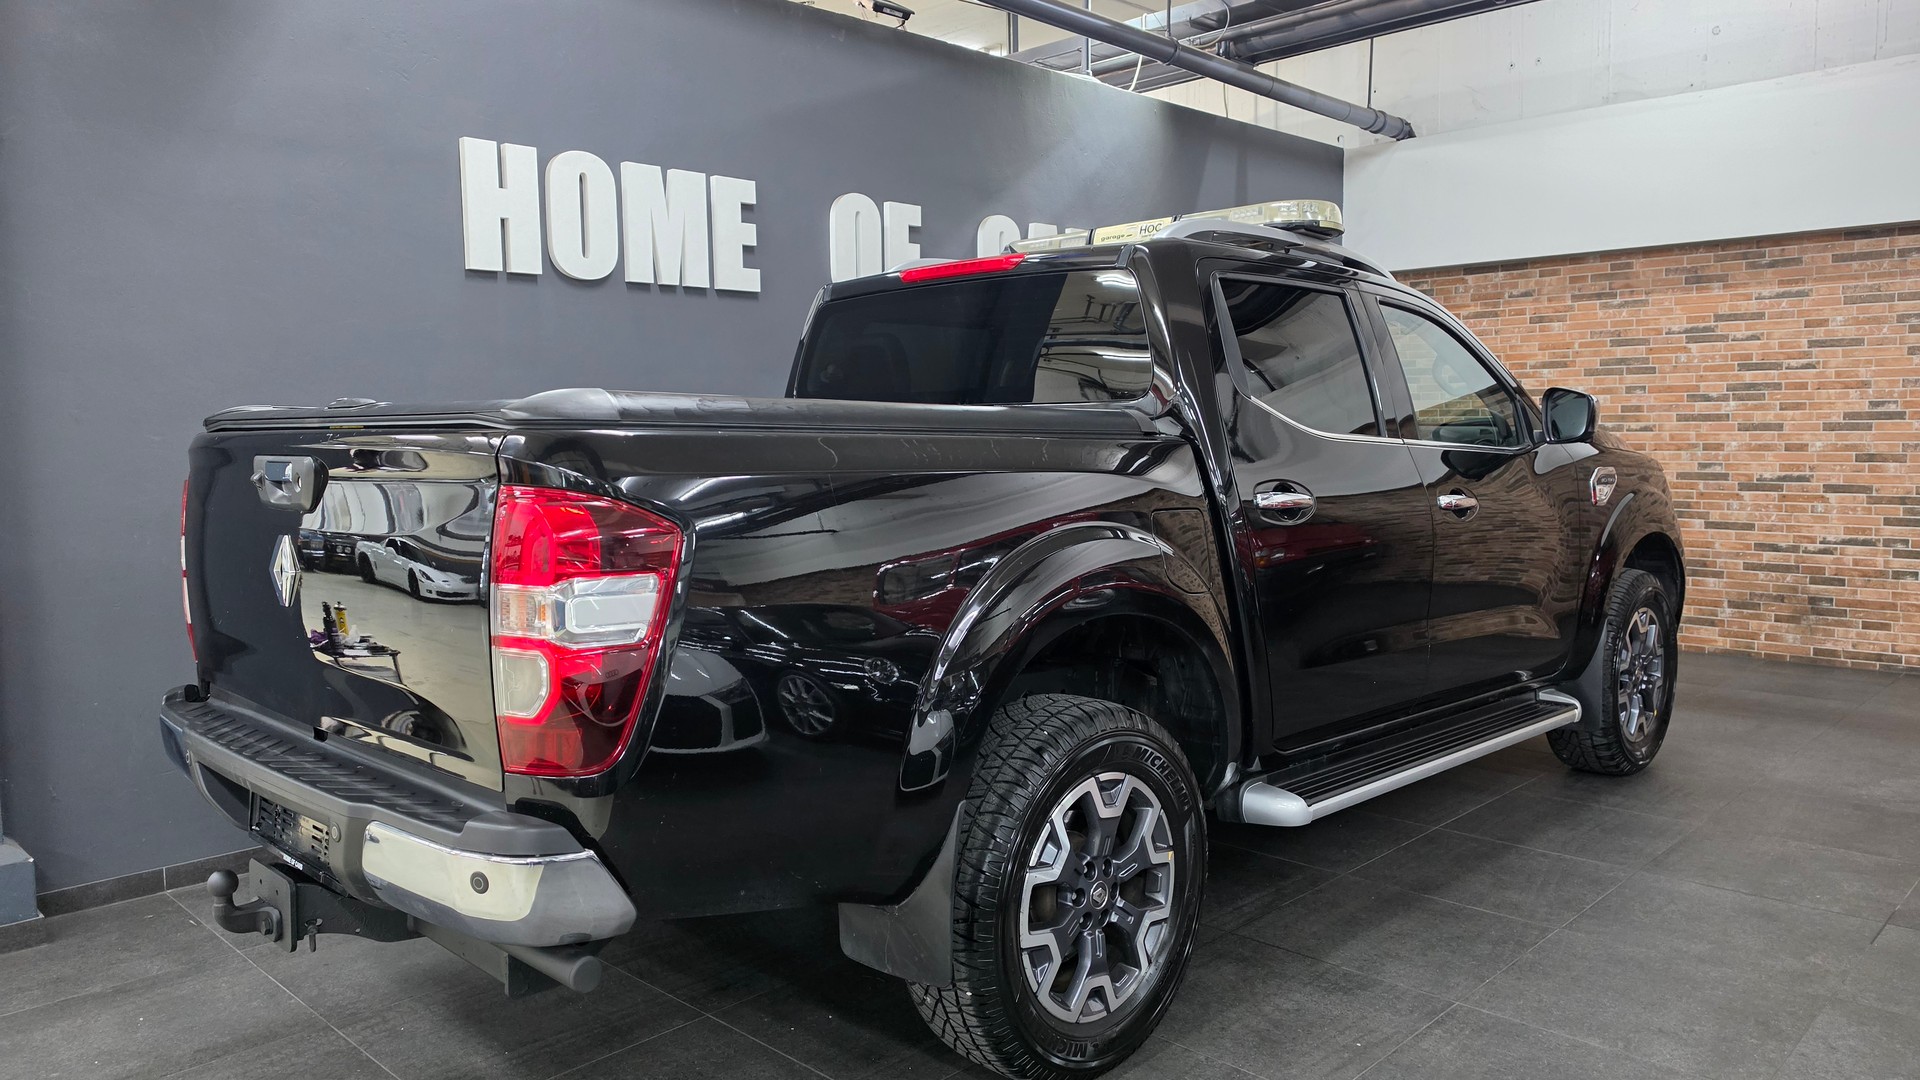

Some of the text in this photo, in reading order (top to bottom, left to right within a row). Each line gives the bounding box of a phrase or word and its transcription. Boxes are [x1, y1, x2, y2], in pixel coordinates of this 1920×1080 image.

[459, 136, 922, 293] HOME OF
[1139, 222, 1162, 235] HOC
[1100, 234, 1125, 242] garage
